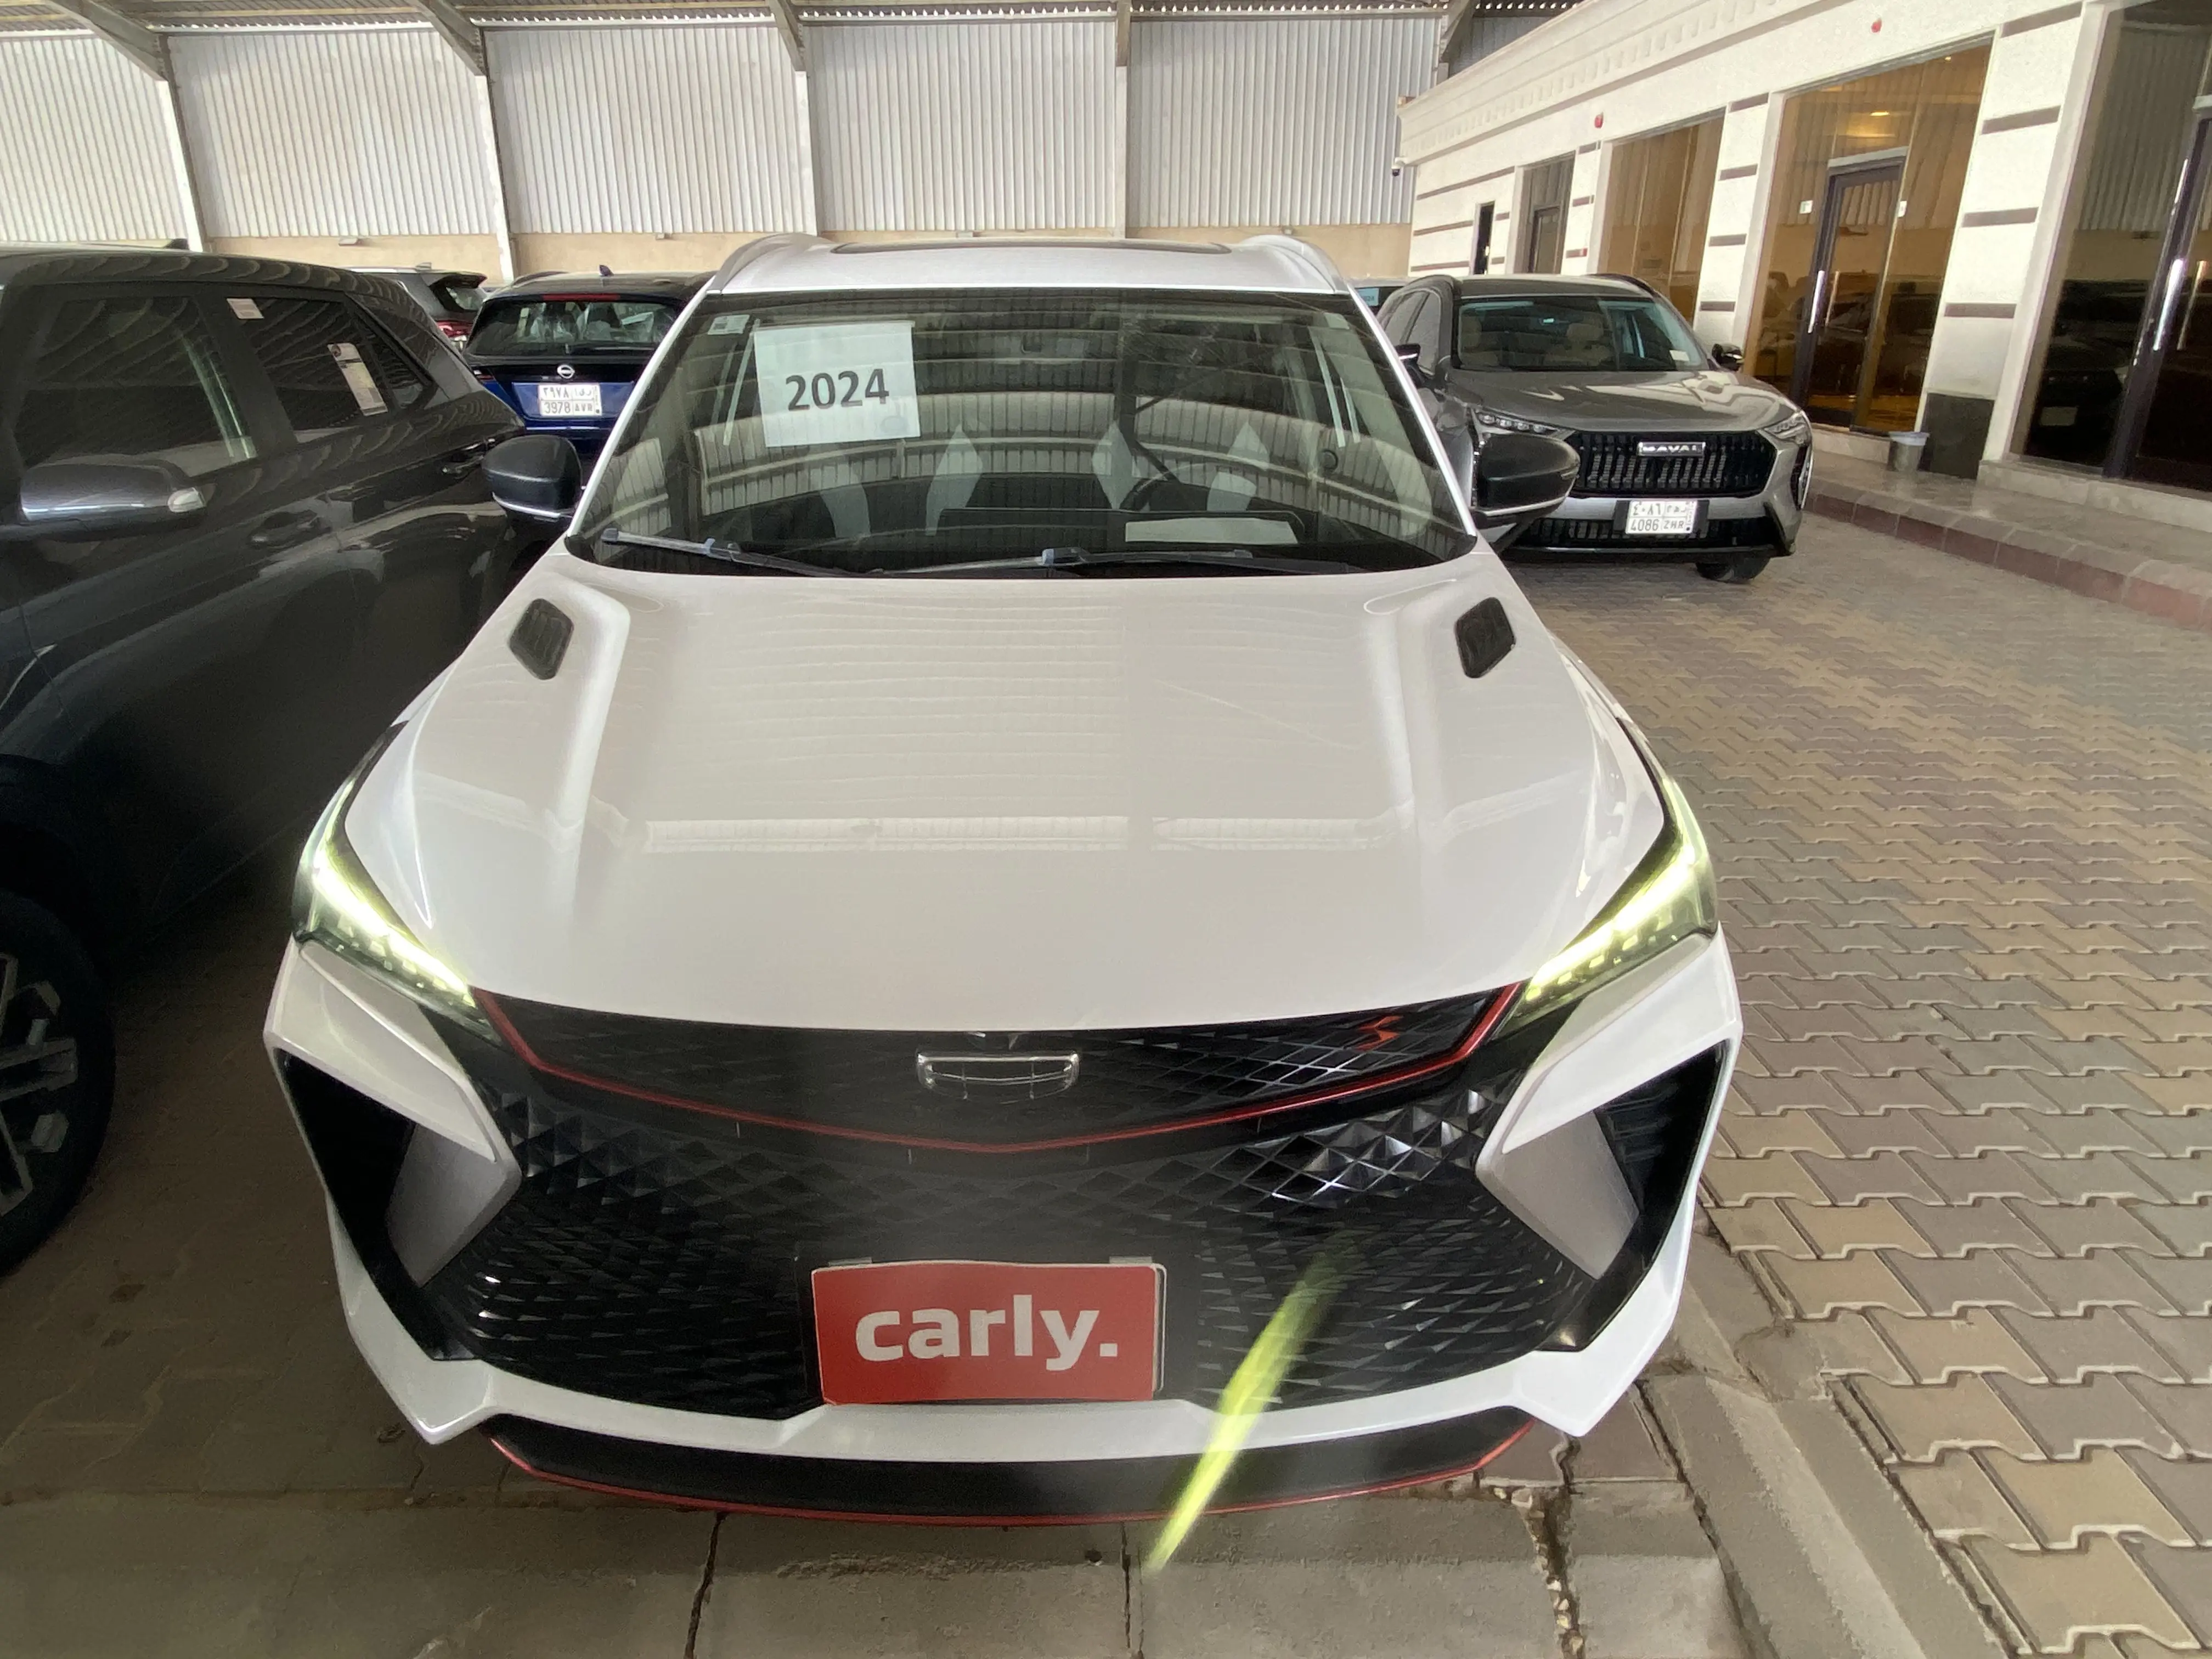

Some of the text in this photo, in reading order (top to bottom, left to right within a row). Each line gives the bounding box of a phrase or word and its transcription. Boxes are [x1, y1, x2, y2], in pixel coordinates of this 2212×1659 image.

[786, 368, 889, 411] 2024
[544, 401, 571, 414] 3978
[1630, 518, 1660, 531] 4086
[855, 1294, 1118, 1370] carly.
